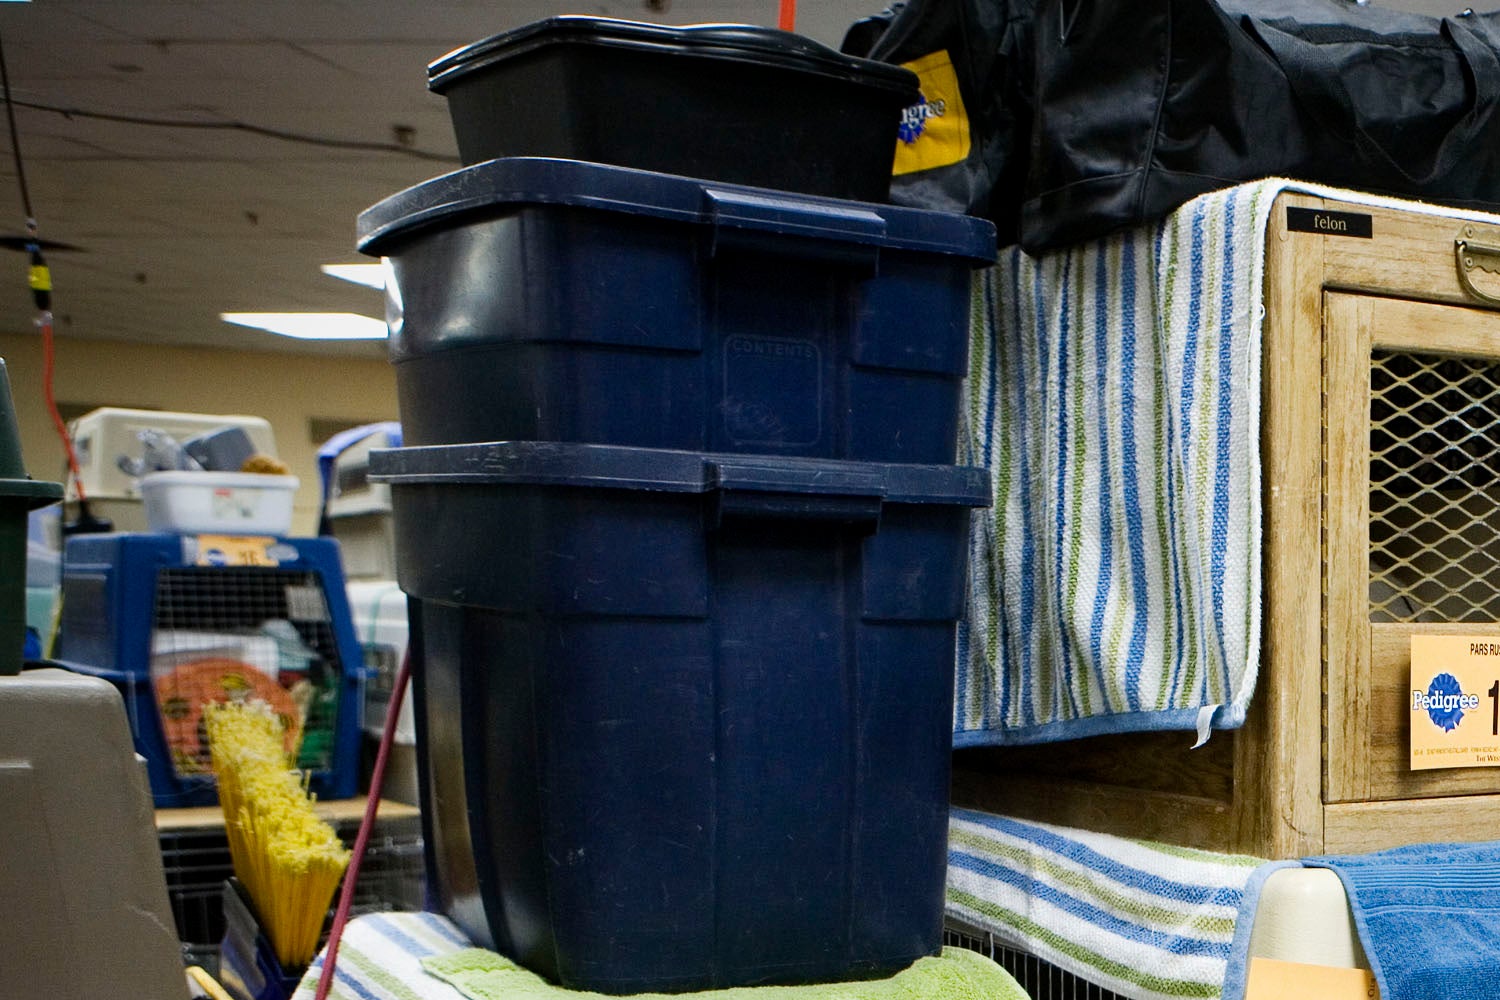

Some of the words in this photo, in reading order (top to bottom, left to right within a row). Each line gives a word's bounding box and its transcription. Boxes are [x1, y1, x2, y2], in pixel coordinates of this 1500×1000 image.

[900, 99, 945, 129] igree
[1313, 214, 1348, 231] felon
[732, 339, 813, 358] CONTENTS
[1470, 643, 1488, 656] PARS
[1412, 690, 1479, 713] Pedigree
